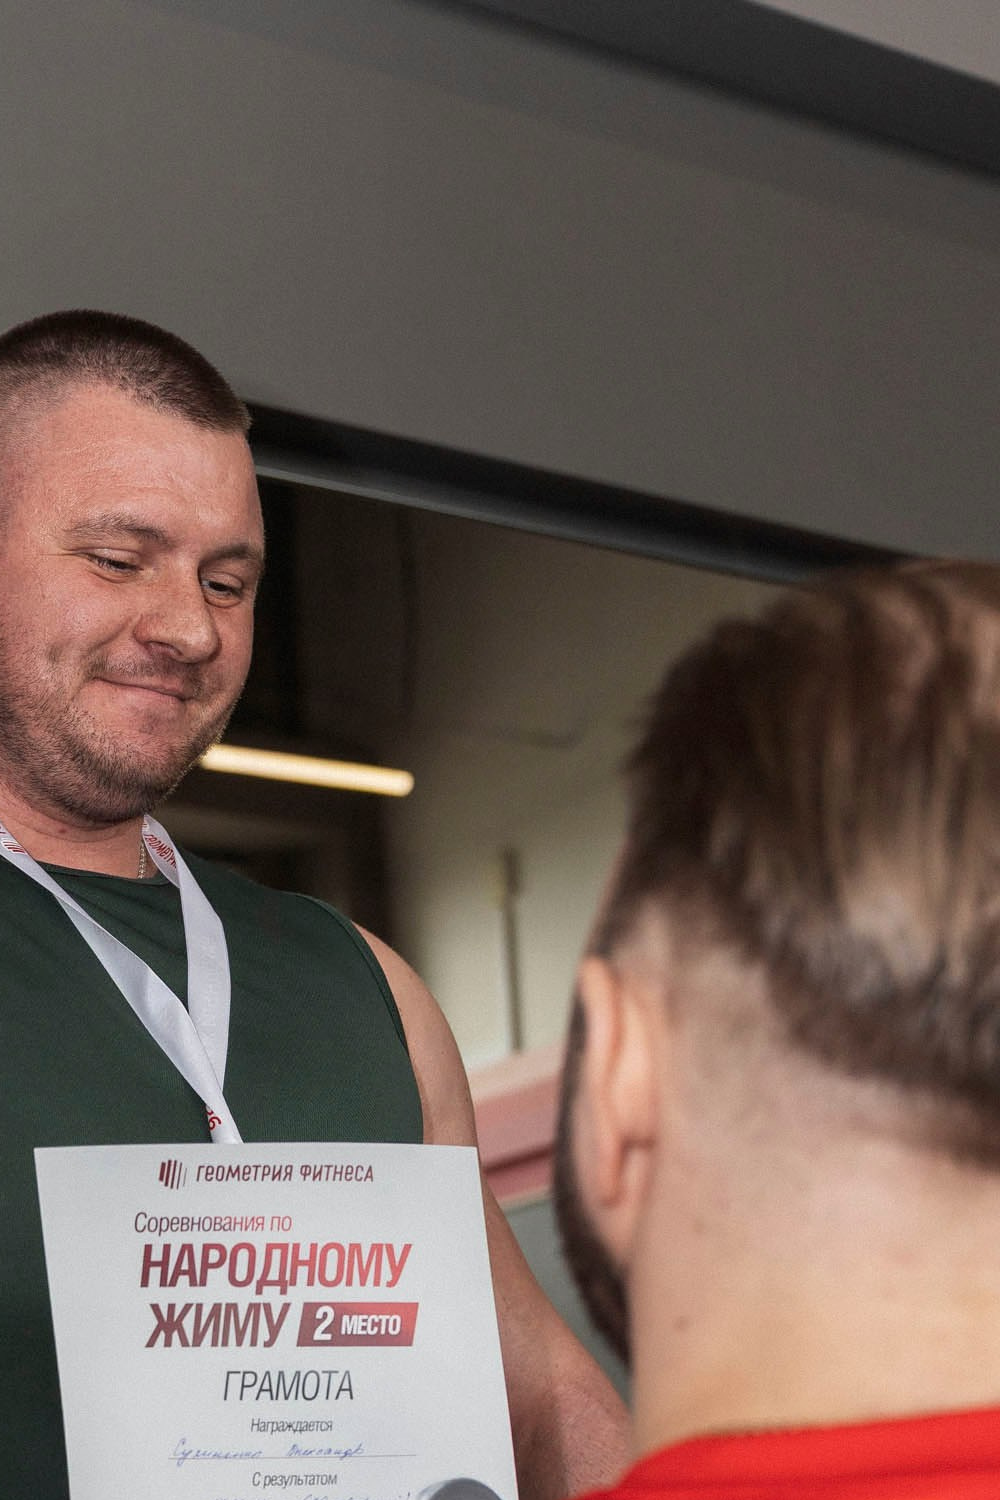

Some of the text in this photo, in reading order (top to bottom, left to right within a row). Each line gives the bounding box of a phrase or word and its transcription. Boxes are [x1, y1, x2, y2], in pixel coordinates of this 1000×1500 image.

[196, 1161, 374, 1182] ГЕОМЕТРИЯ ФИТНЕСА
[134, 1211, 293, 1237] Соревнования по
[139, 1242, 413, 1295] НАРОДНОМУ
[144, 1302, 292, 1348] ЖИМУ
[313, 1305, 402, 1341] 2 МЕСТО
[223, 1370, 355, 1401] ГРАМОТА
[250, 1417, 334, 1435] Награждается
[252, 1471, 338, 1489] С результатом
